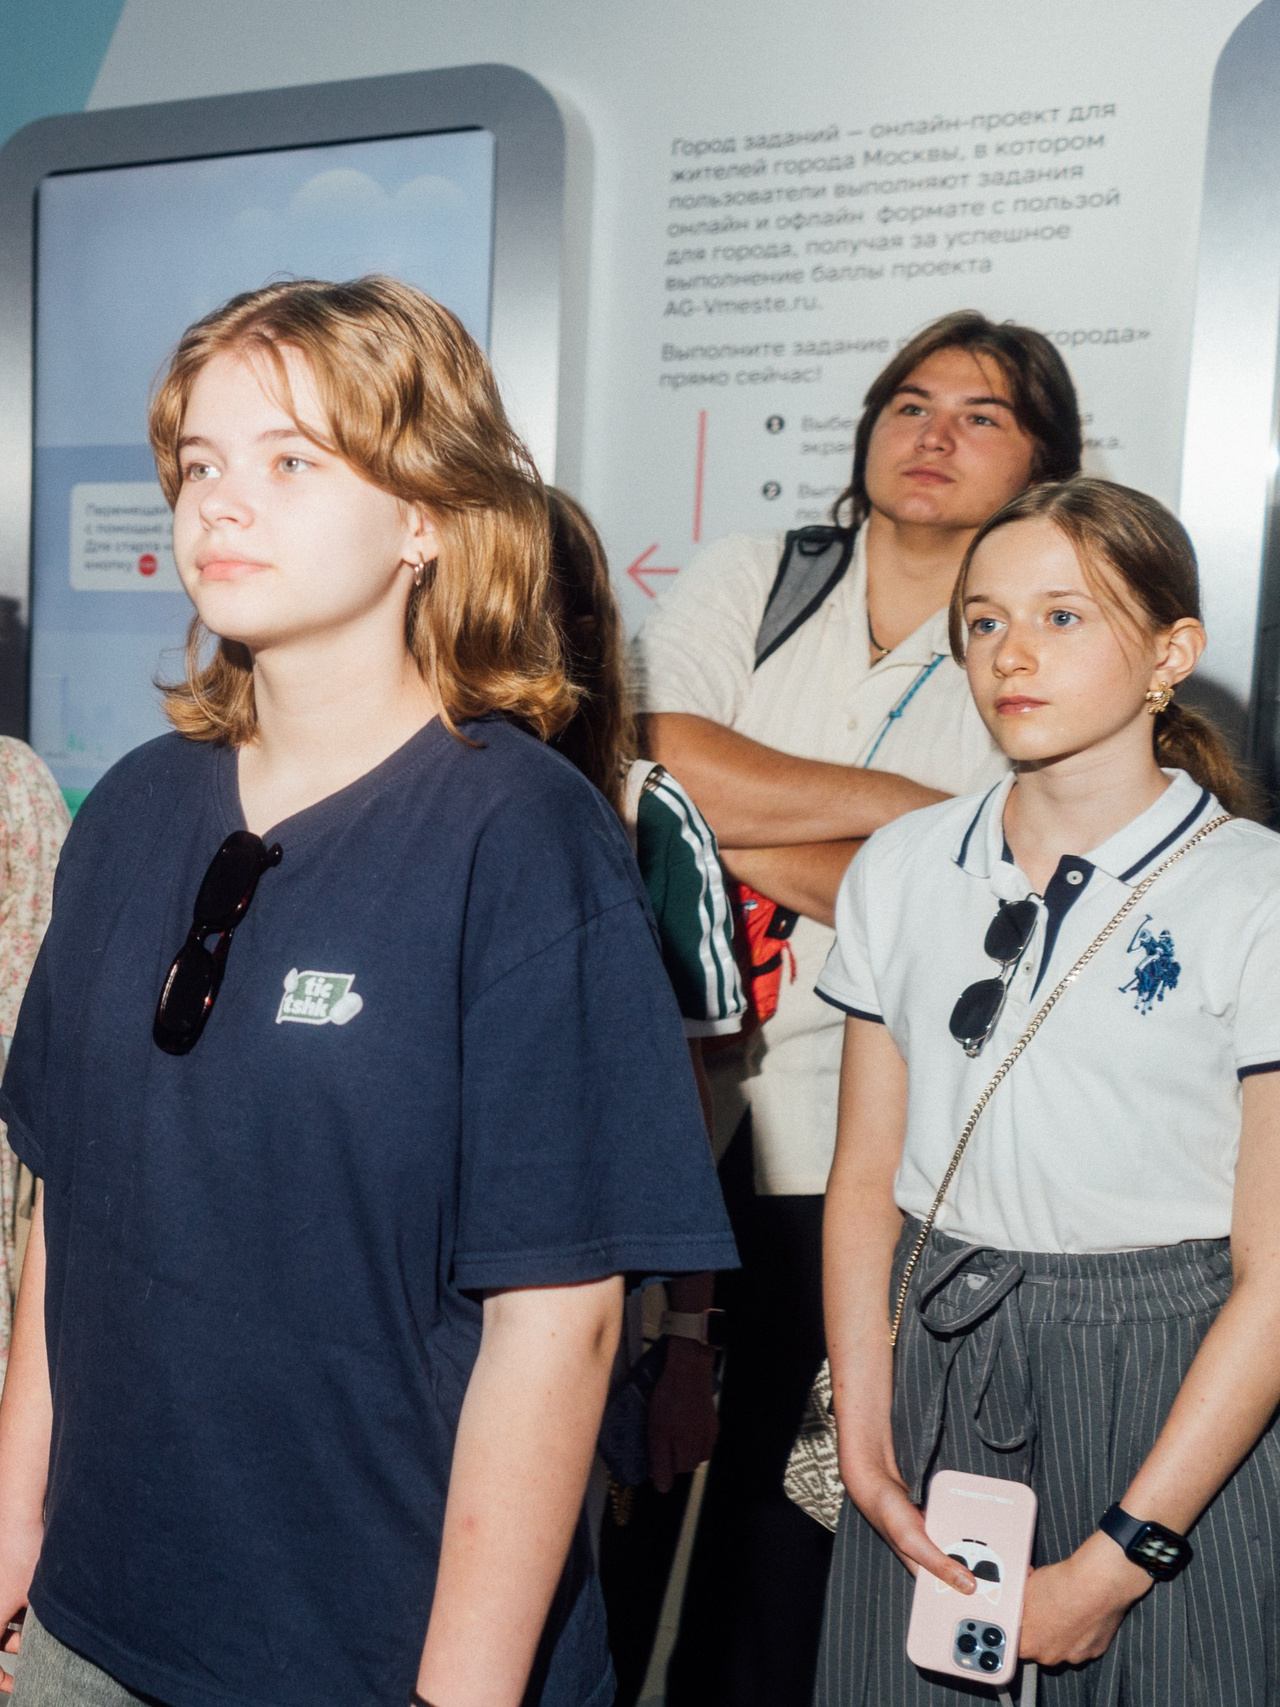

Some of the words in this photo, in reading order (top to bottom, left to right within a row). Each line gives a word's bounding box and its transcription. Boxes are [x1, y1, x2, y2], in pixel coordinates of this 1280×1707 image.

[672, 137, 736, 158] Город
[743, 123, 839, 150] заданий
[870, 109, 1061, 139] онлайн-проект
[1068, 103, 1116, 123] для
[671, 158, 767, 182] жителей
[773, 154, 854, 176] города
[863, 146, 965, 166] Москвы,
[973, 143, 987, 159] в
[994, 134, 1105, 157] котором
[669, 186, 826, 210] пользователи
[834, 171, 970, 198] выполняют
[978, 164, 1084, 187] задания
[667, 214, 748, 238] онлайн
[756, 218, 768, 230] и
[776, 206, 863, 231] офлайн
[877, 201, 985, 223] формате
[992, 199, 1005, 215] с
[1013, 188, 1120, 213] пользой
[666, 249, 705, 266] для
[711, 243, 798, 262] города,
[806, 236, 903, 257] получая
[911, 232, 937, 249] за
[945, 224, 1070, 251] успешное
[665, 270, 805, 292] выполнение
[811, 265, 884, 283] баллы
[891, 257, 992, 280] проекта
[662, 341, 785, 362] Выполните
[792, 336, 889, 357] задание
[660, 370, 729, 391] прямо
[304, 977, 334, 998] tic
